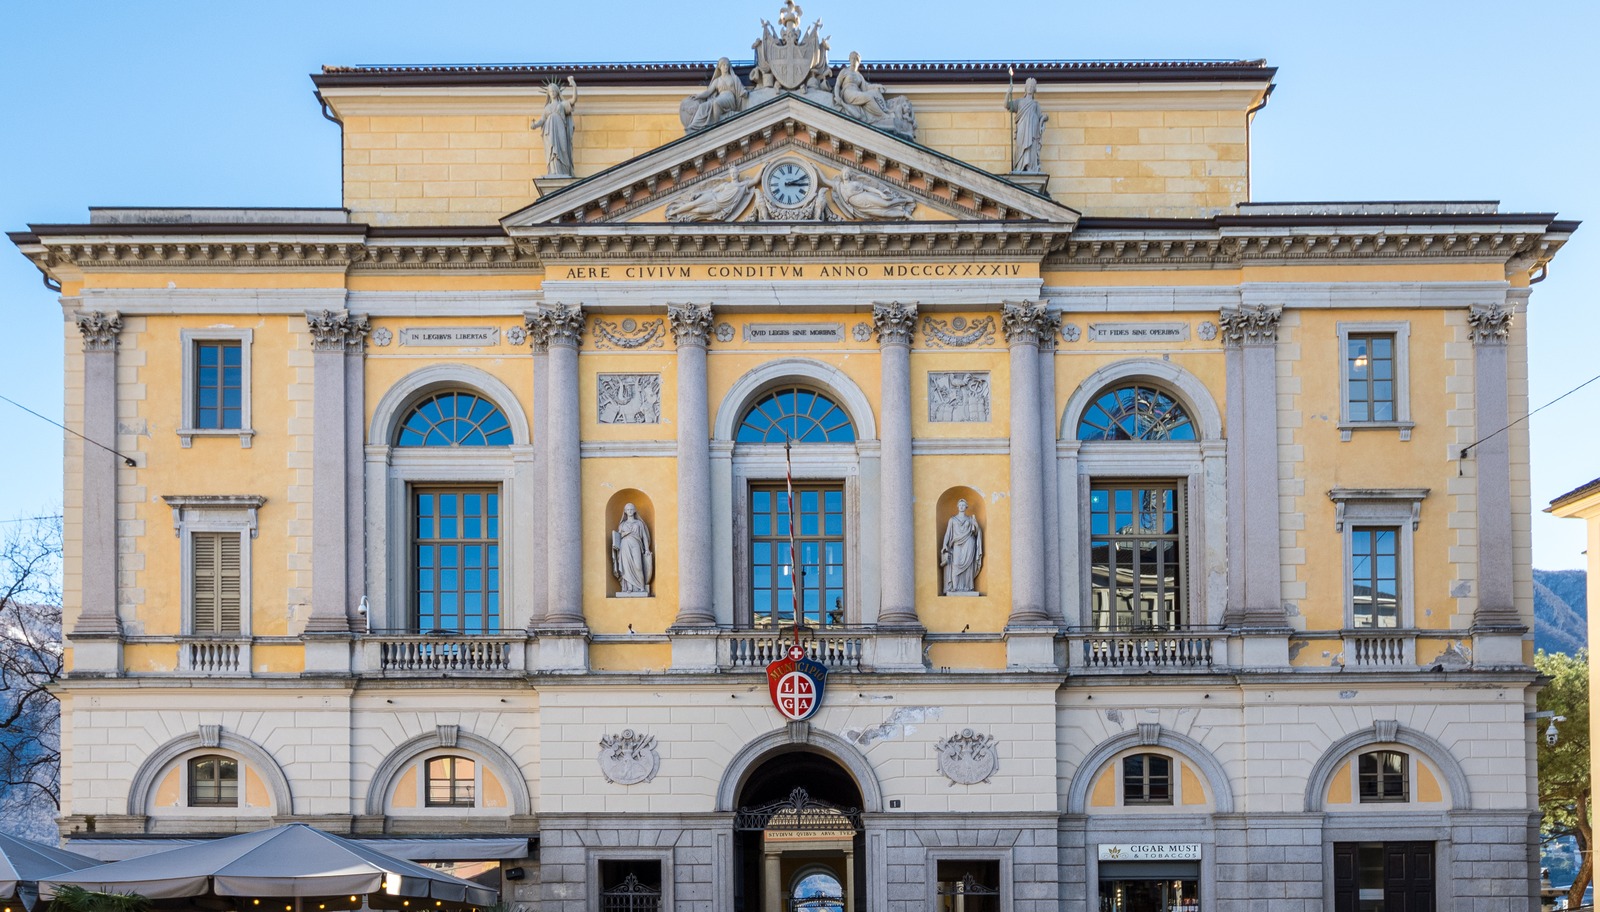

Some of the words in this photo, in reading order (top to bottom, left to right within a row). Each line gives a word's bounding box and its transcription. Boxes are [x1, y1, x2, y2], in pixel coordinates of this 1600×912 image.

[566, 267, 610, 279] AERE
[625, 267, 691, 278] CIVIVM
[707, 266, 804, 278] CONDITVM
[819, 266, 869, 277] ANNO
[883, 264, 1021, 277] MDCCCXXXXIV
[770, 662, 825, 681] MUNICIPIO
